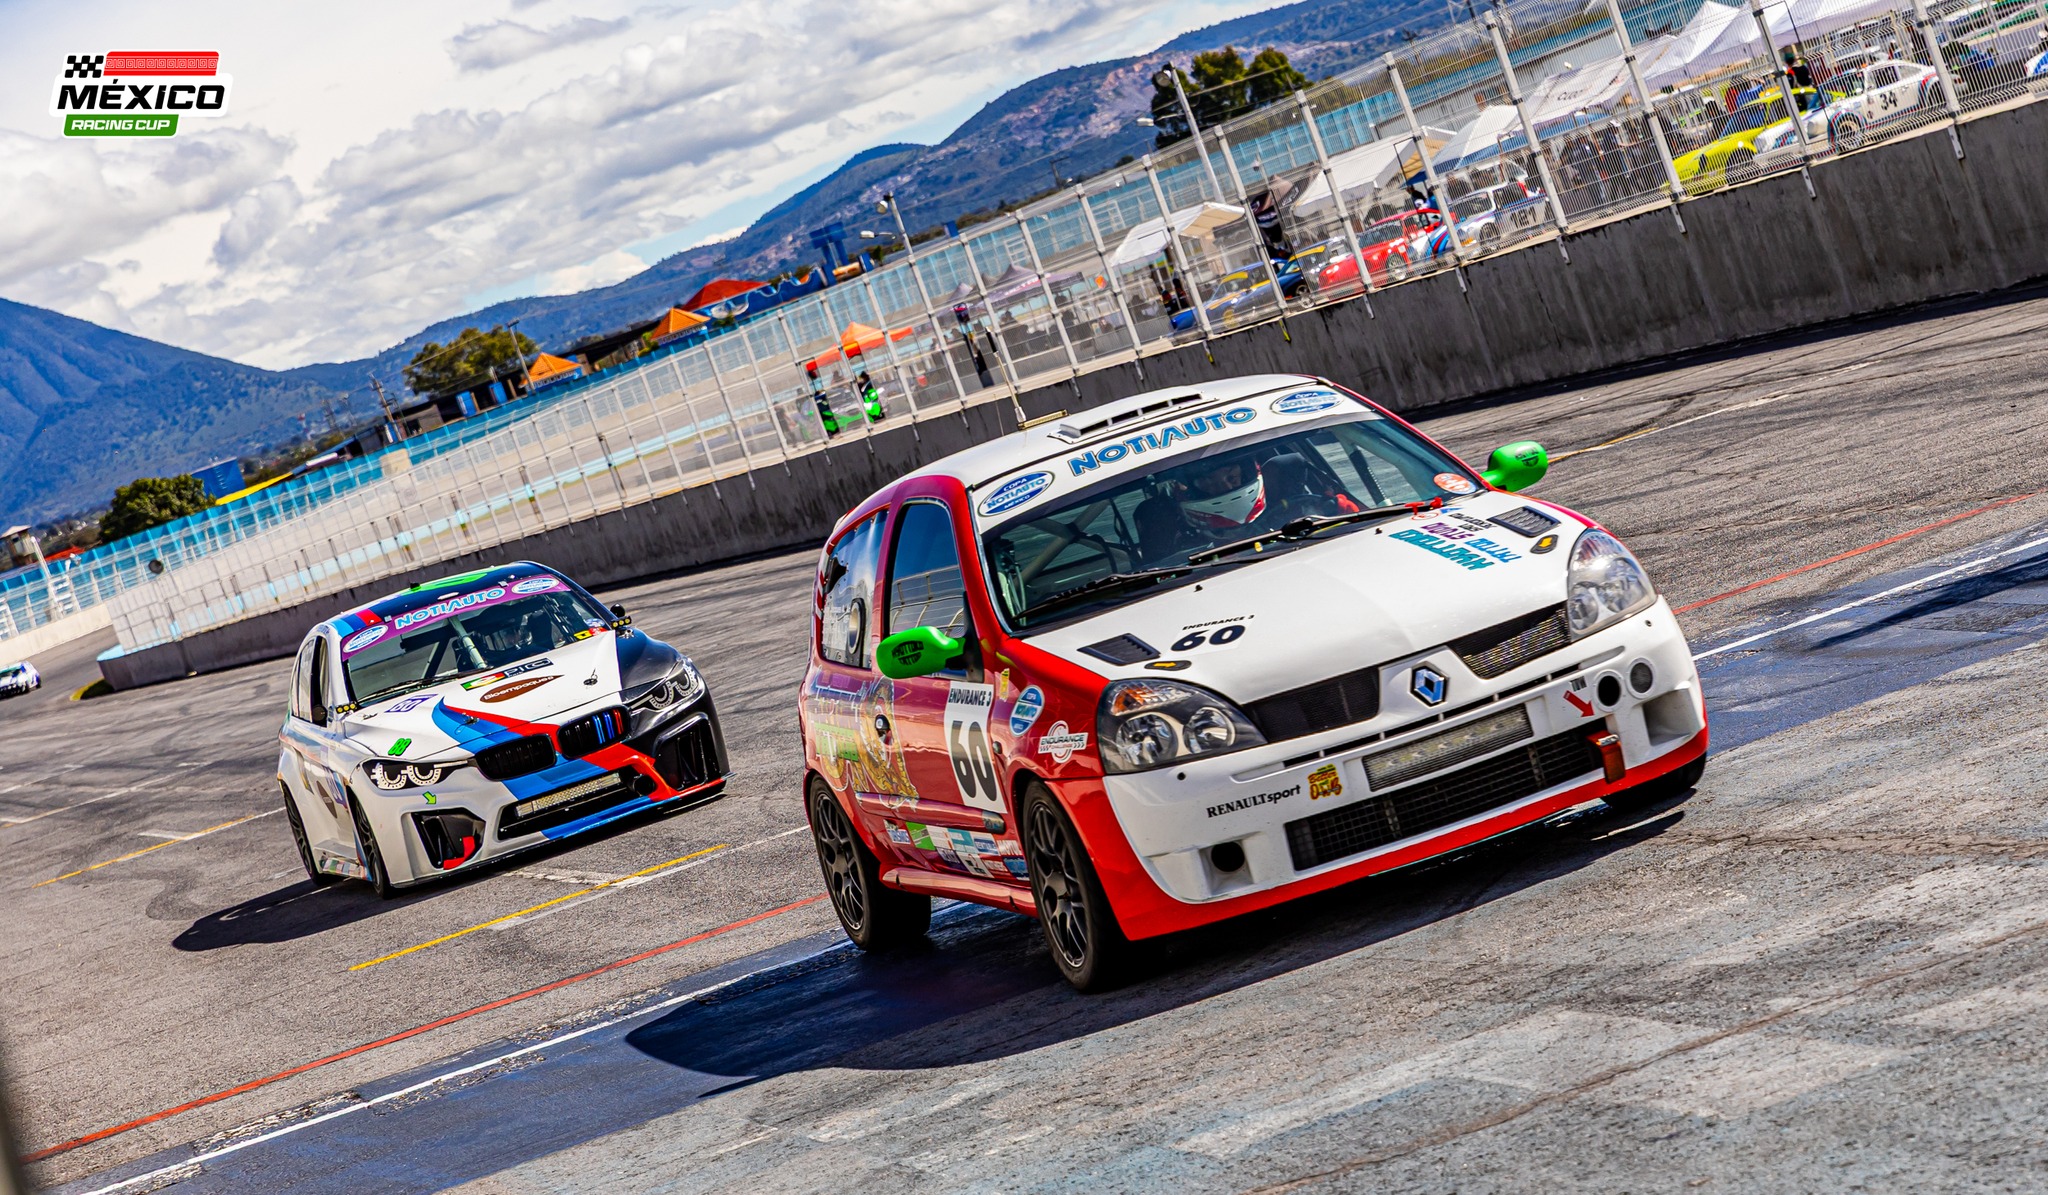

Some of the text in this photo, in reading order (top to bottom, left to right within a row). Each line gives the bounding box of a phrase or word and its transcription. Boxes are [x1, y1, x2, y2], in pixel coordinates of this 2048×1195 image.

[1880, 90, 1898, 110] 34
[1067, 407, 1257, 476] NOTIAUTO
[986, 478, 1046, 509] NOTIAUTO
[1003, 478, 1027, 492] COPA
[394, 587, 506, 629] NOTIAUTO
[1182, 616, 1245, 631] ENDURANCE
[1170, 625, 1246, 652] 60
[483, 675, 554, 701] Bioempaques
[948, 688, 992, 707] ENDURANCE 3
[387, 737, 412, 756] 88
[1040, 734, 1086, 746] ENDURANCE
[950, 720, 998, 802] 60
